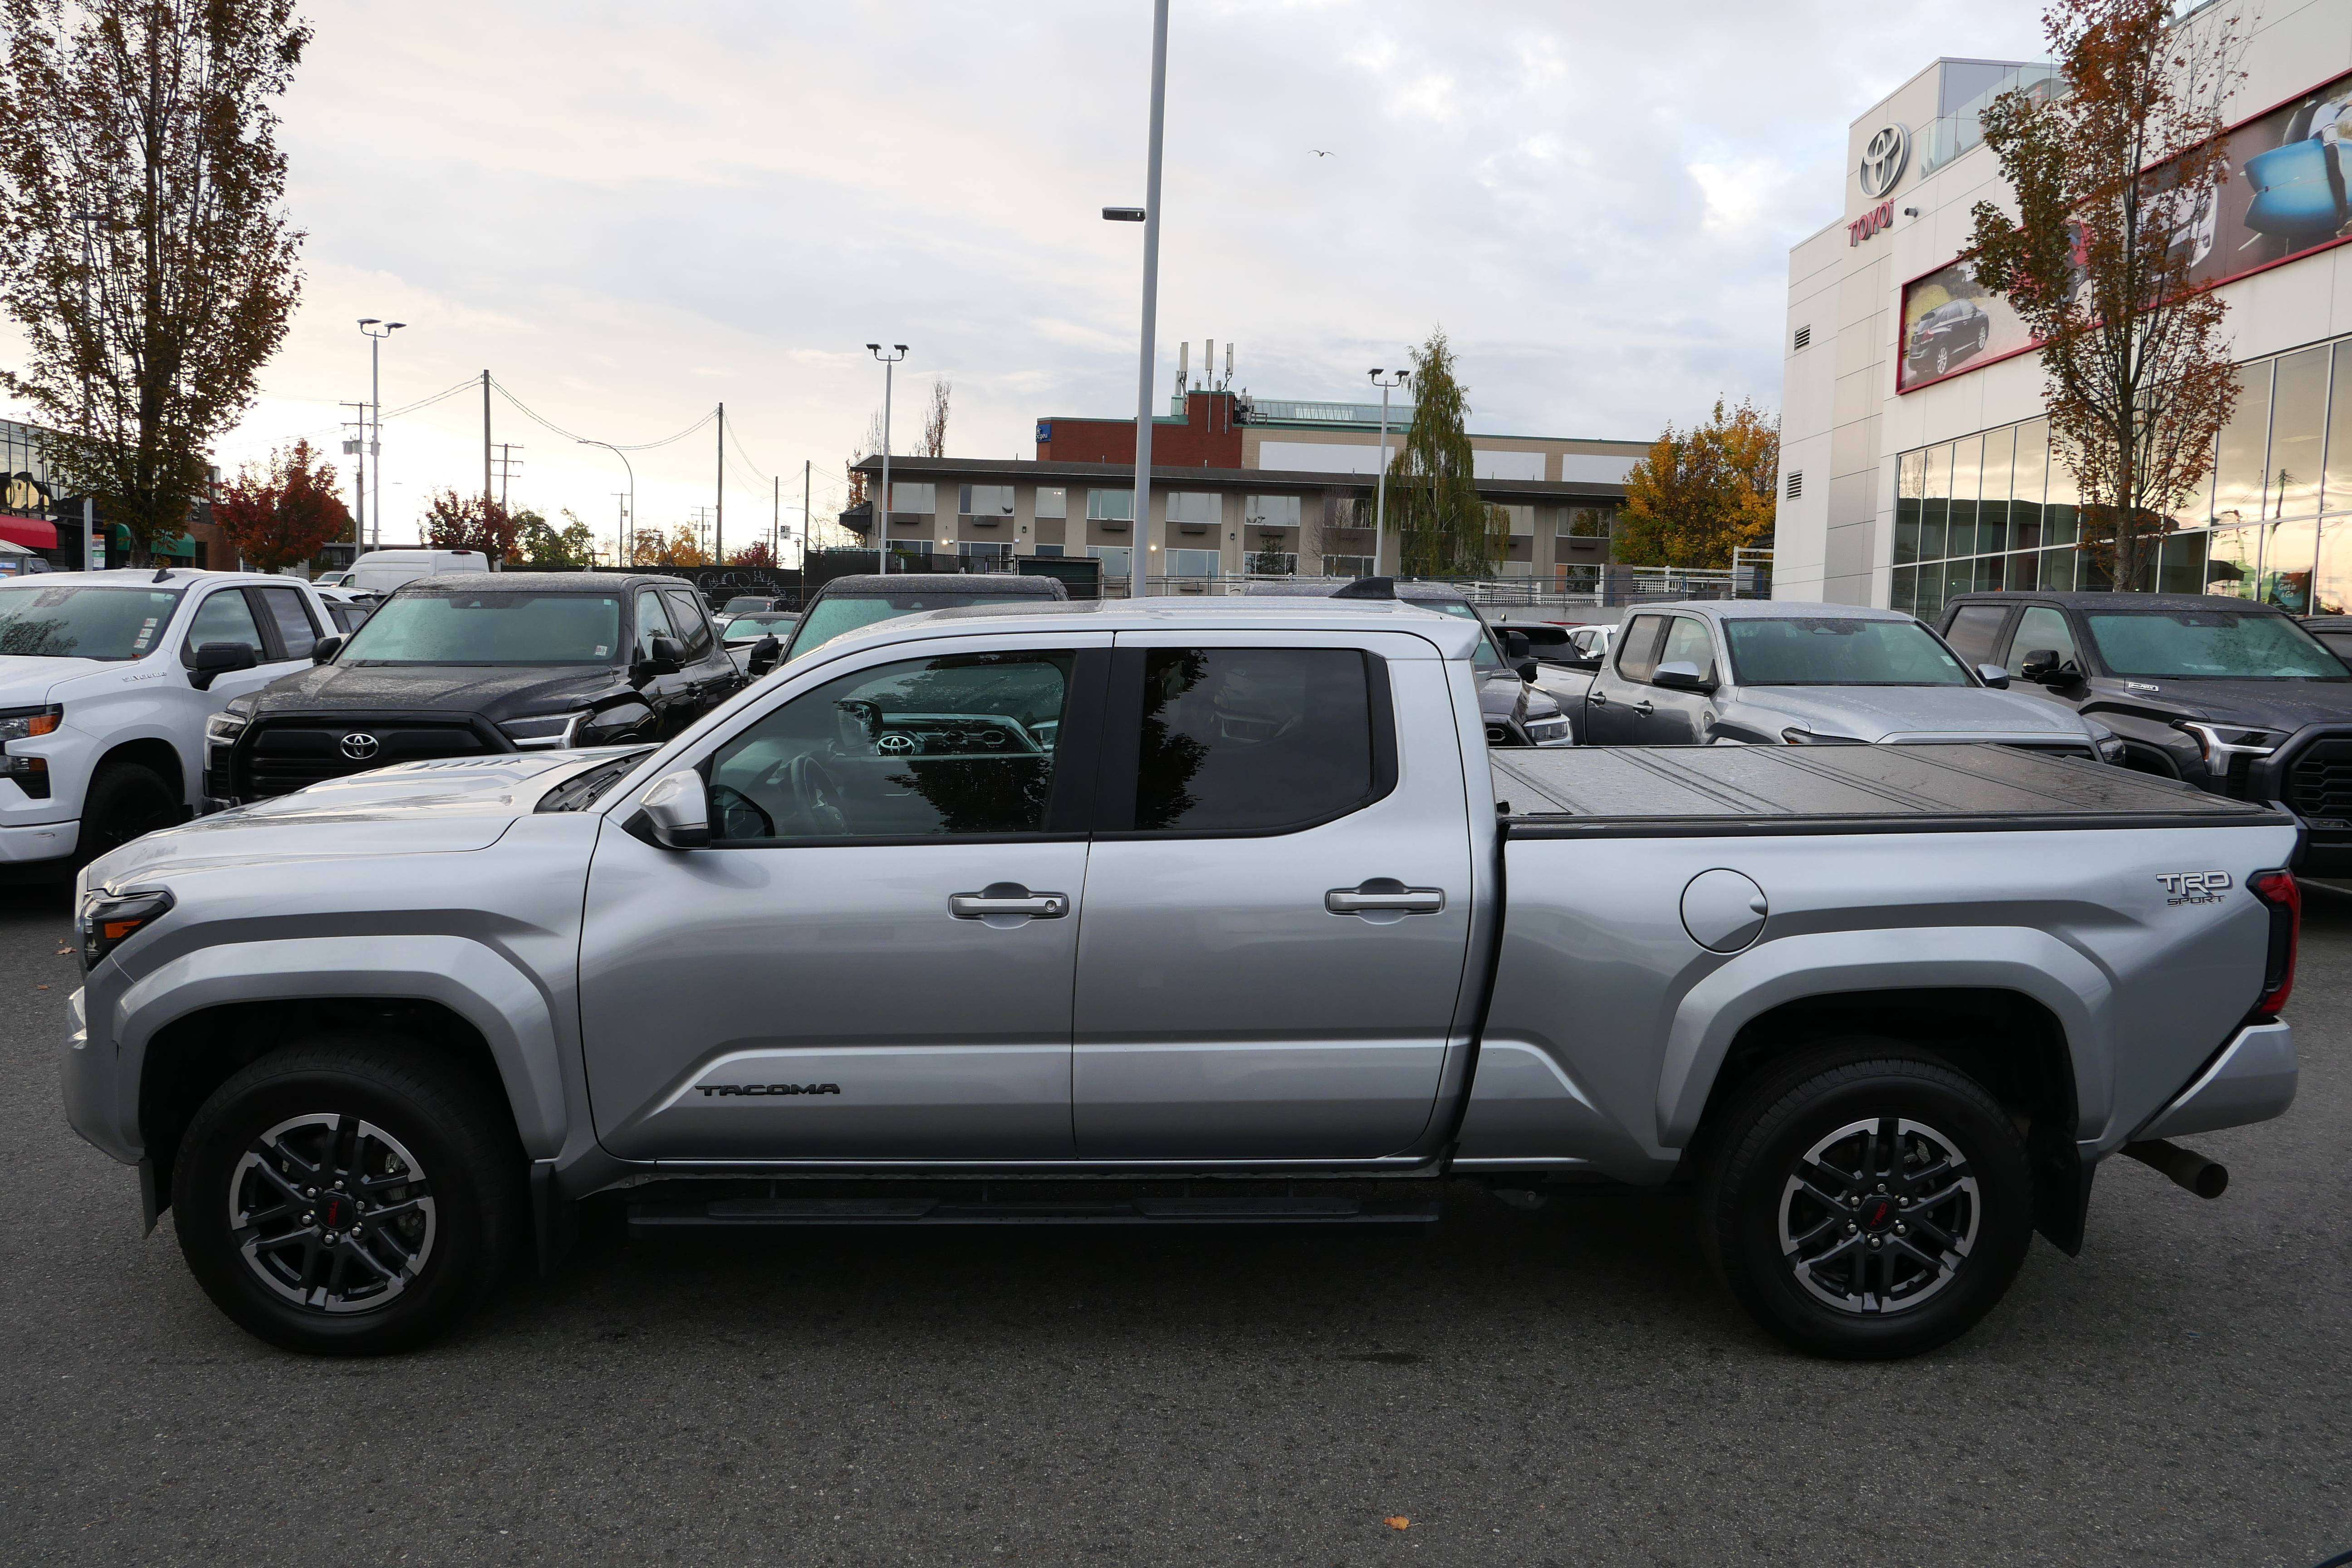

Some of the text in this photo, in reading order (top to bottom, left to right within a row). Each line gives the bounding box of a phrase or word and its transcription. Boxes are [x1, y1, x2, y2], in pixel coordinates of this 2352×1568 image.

[2156, 870, 2233, 896] TRD
[2167, 896, 2226, 906] SPORT
[695, 1083, 840, 1096] TACOMA
[328, 1200, 339, 1226] TRD
[1869, 1201, 1888, 1227] TRD
